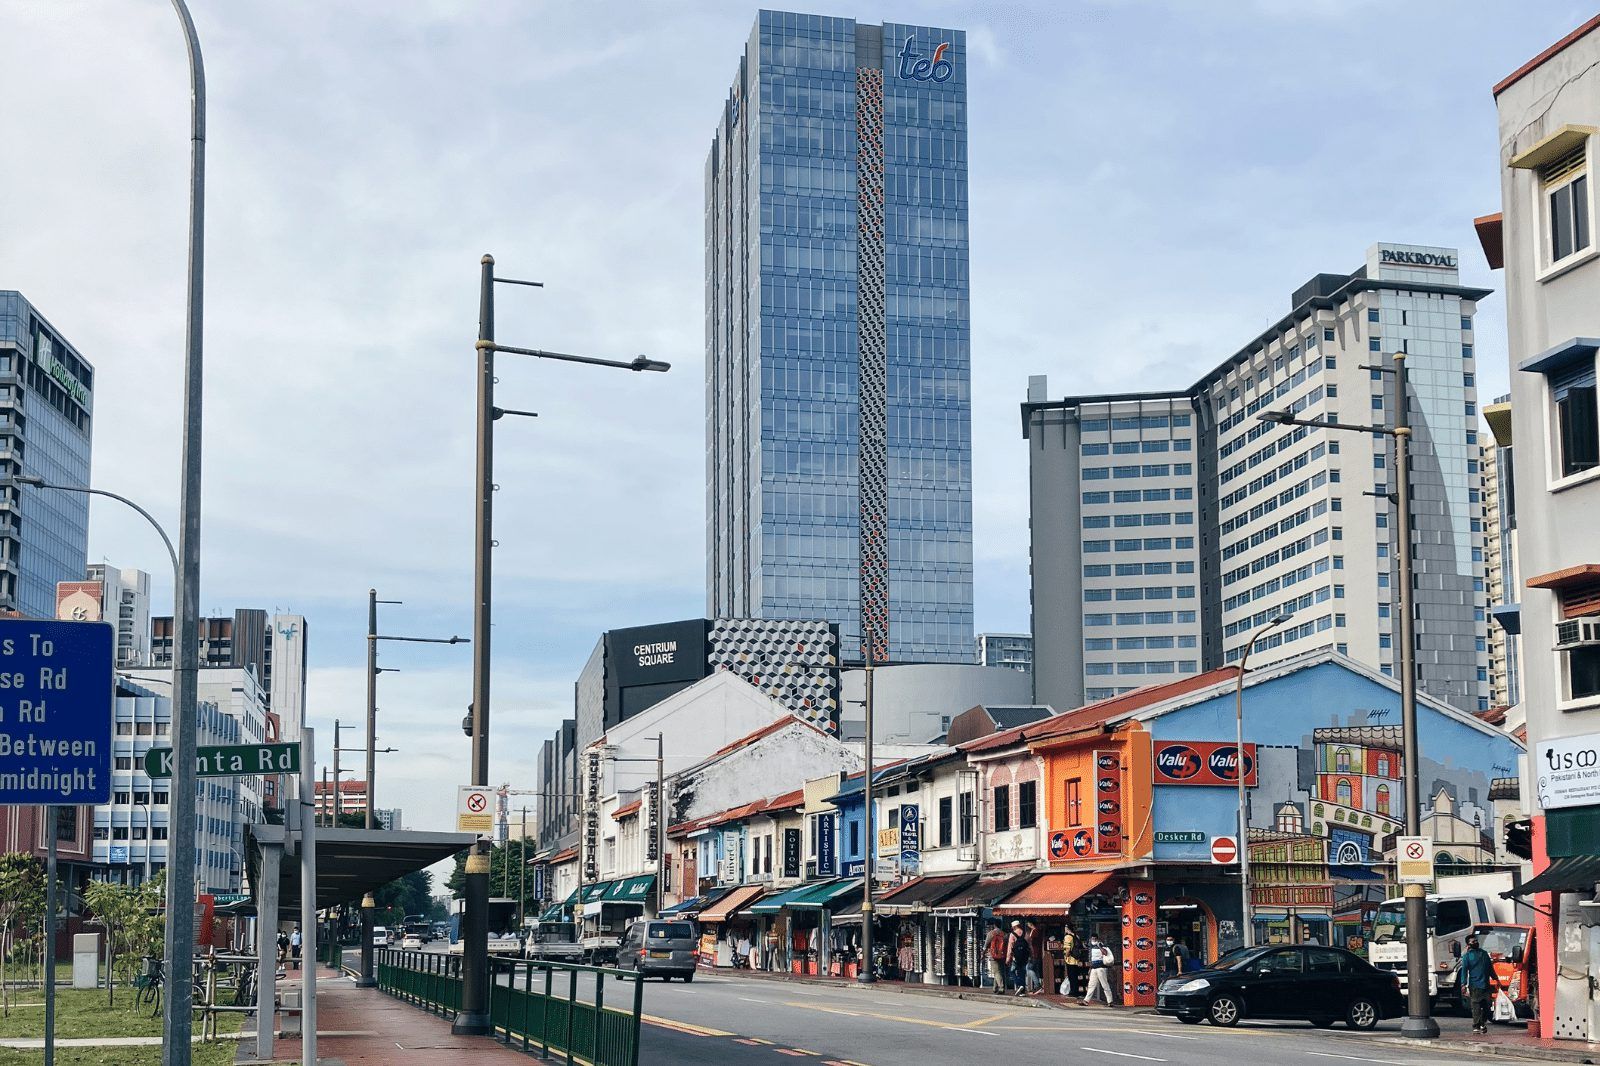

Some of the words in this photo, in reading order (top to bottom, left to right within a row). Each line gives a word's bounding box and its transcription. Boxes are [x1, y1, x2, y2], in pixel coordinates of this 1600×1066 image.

[1382, 249, 1457, 267] PARKROYAL
[29, 633, 54, 657] To
[633, 641, 677, 656] CENTRIUM
[638, 652, 675, 667] SQUARE
[40, 667, 67, 690] Rd
[19, 699, 46, 723] Rd
[0, 733, 96, 757] Between
[161, 750, 243, 774] Knta
[258, 748, 292, 771] Rd
[0, 767, 97, 795] midnight
[1550, 772, 1576, 782] Pakistani
[1577, 771, 1581, 779] &
[1582, 769, 1599, 778] North
[904, 823, 916, 831] A1
[1158, 832, 1188, 841] Desker
[1191, 832, 1202, 841] Rd
[822, 815, 830, 869] ARTISTIC
